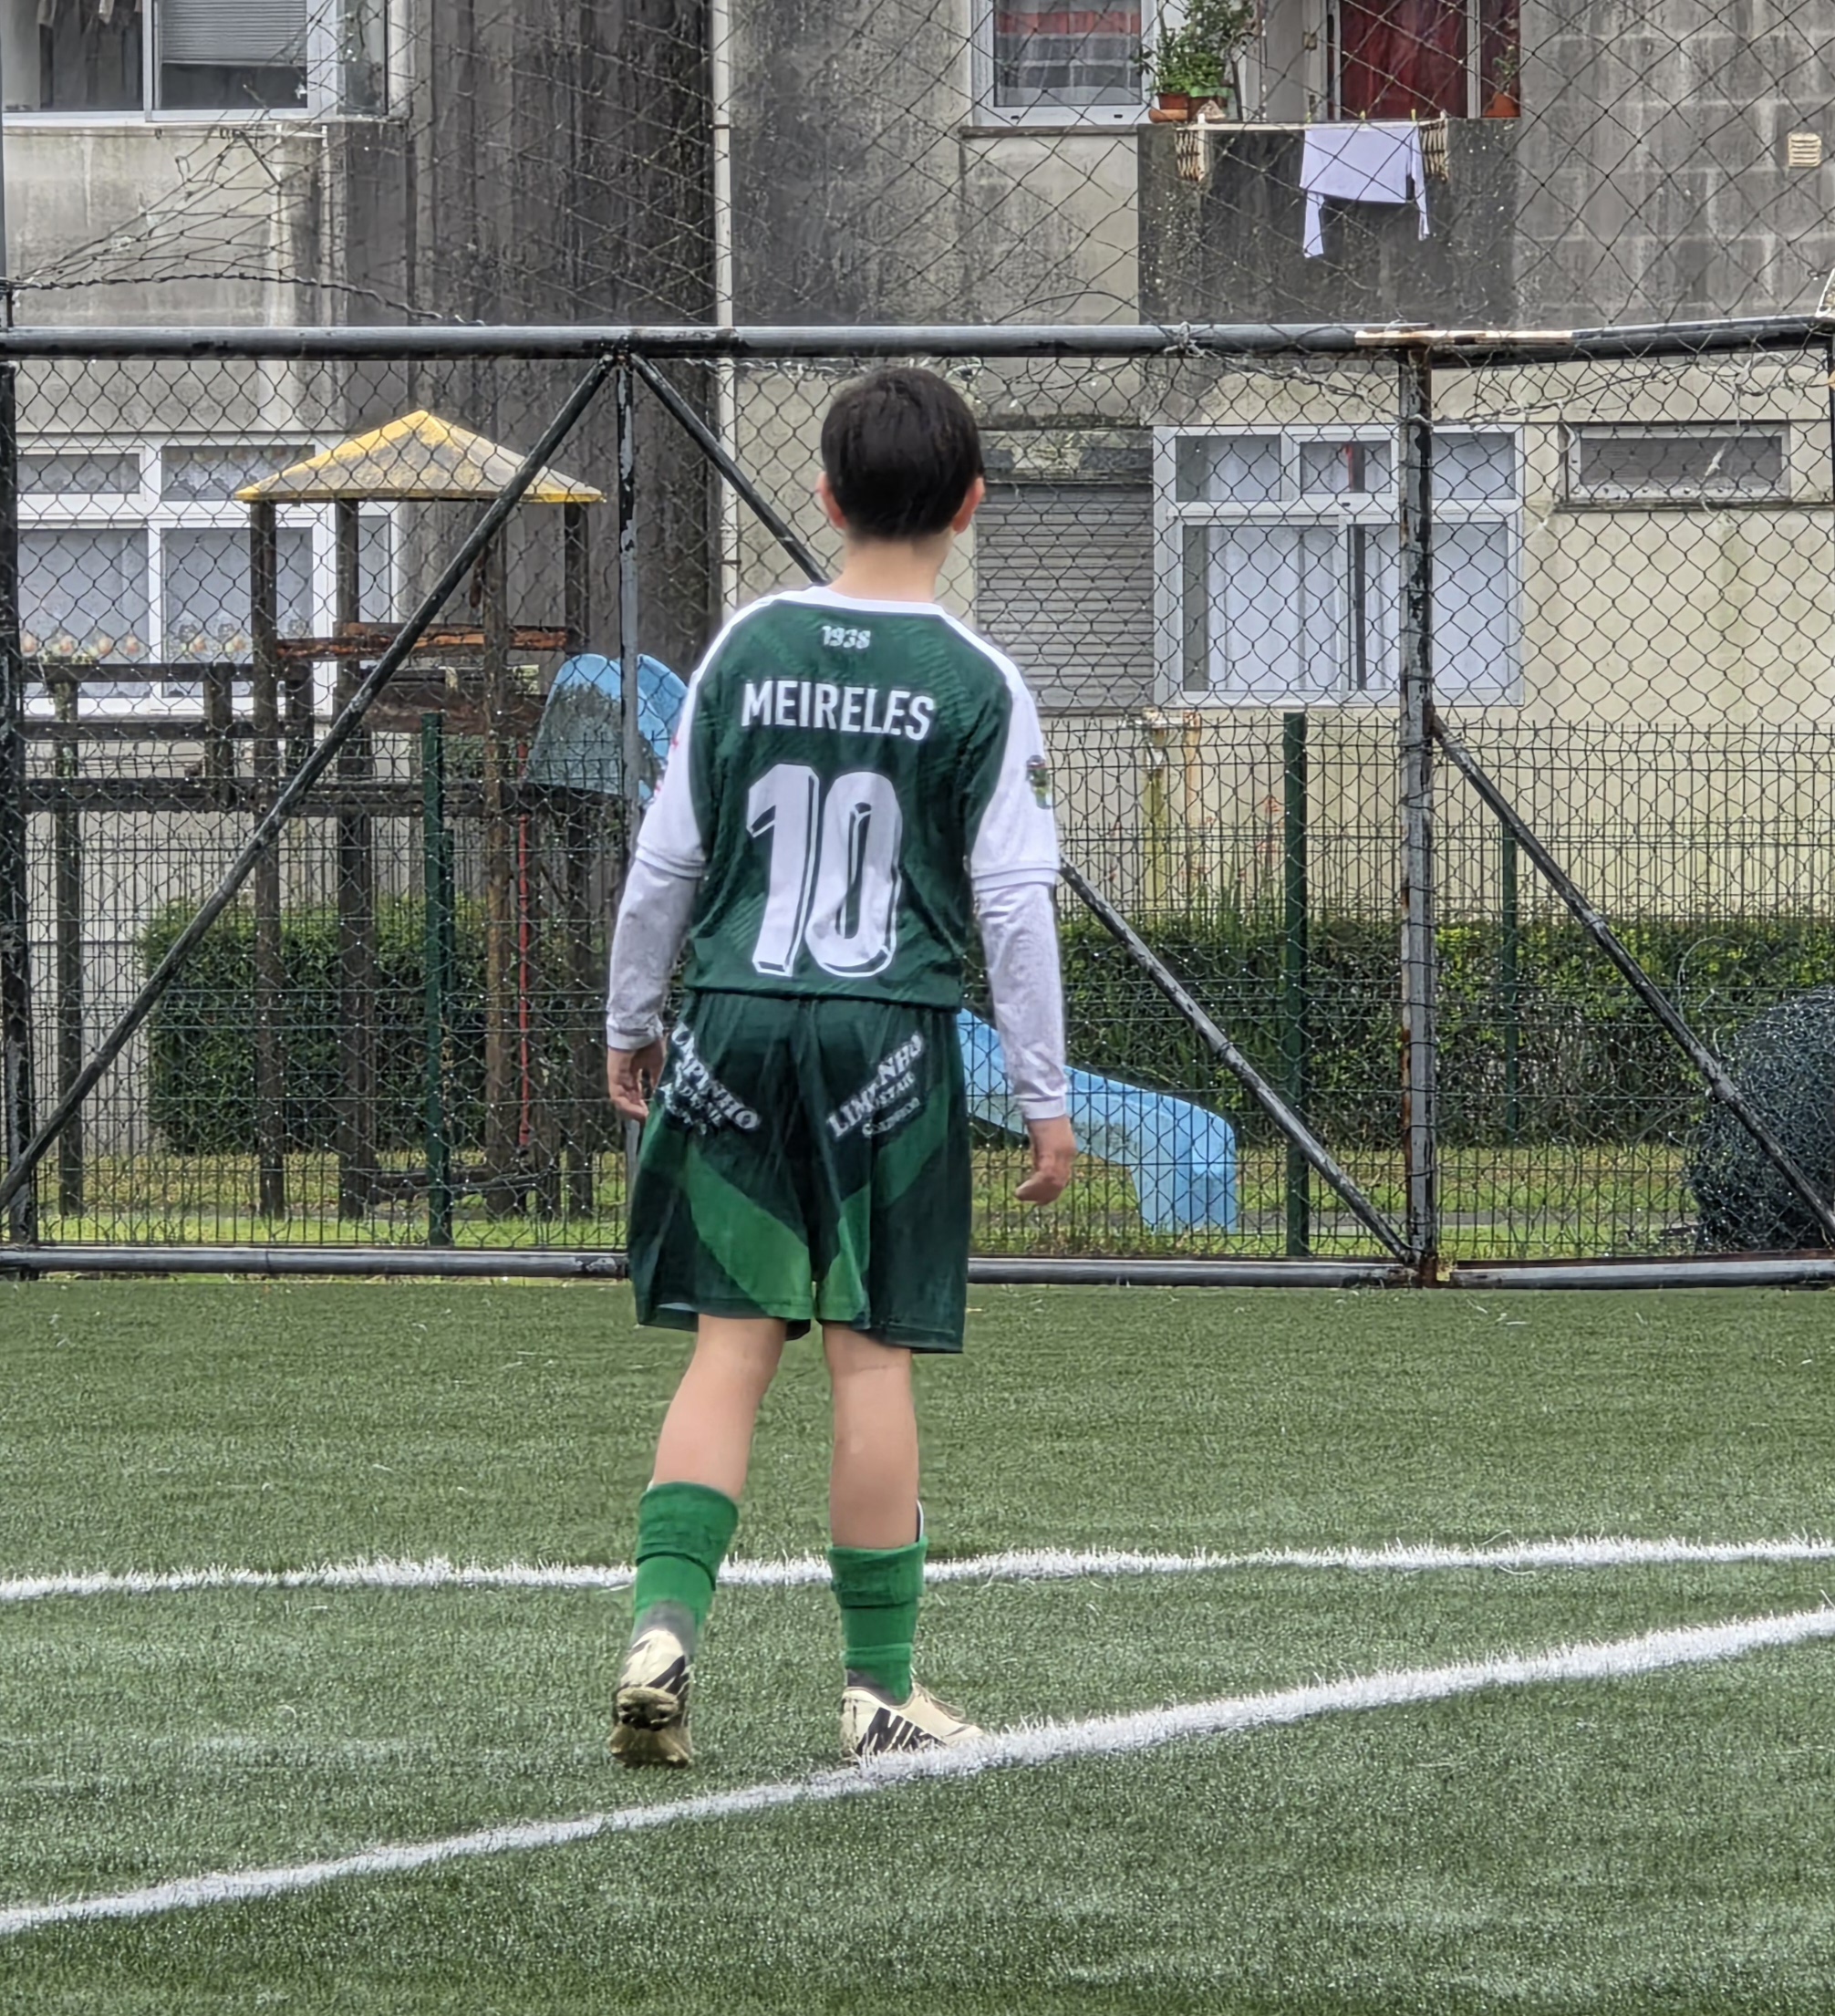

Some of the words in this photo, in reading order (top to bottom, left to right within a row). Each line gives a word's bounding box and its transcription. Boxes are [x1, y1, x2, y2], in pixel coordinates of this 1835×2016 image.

[822, 626, 871, 649] 1938
[741, 680, 935, 741] MEIRELES
[746, 764, 903, 977] 10
[827, 1033, 922, 1138] LIMNHO
